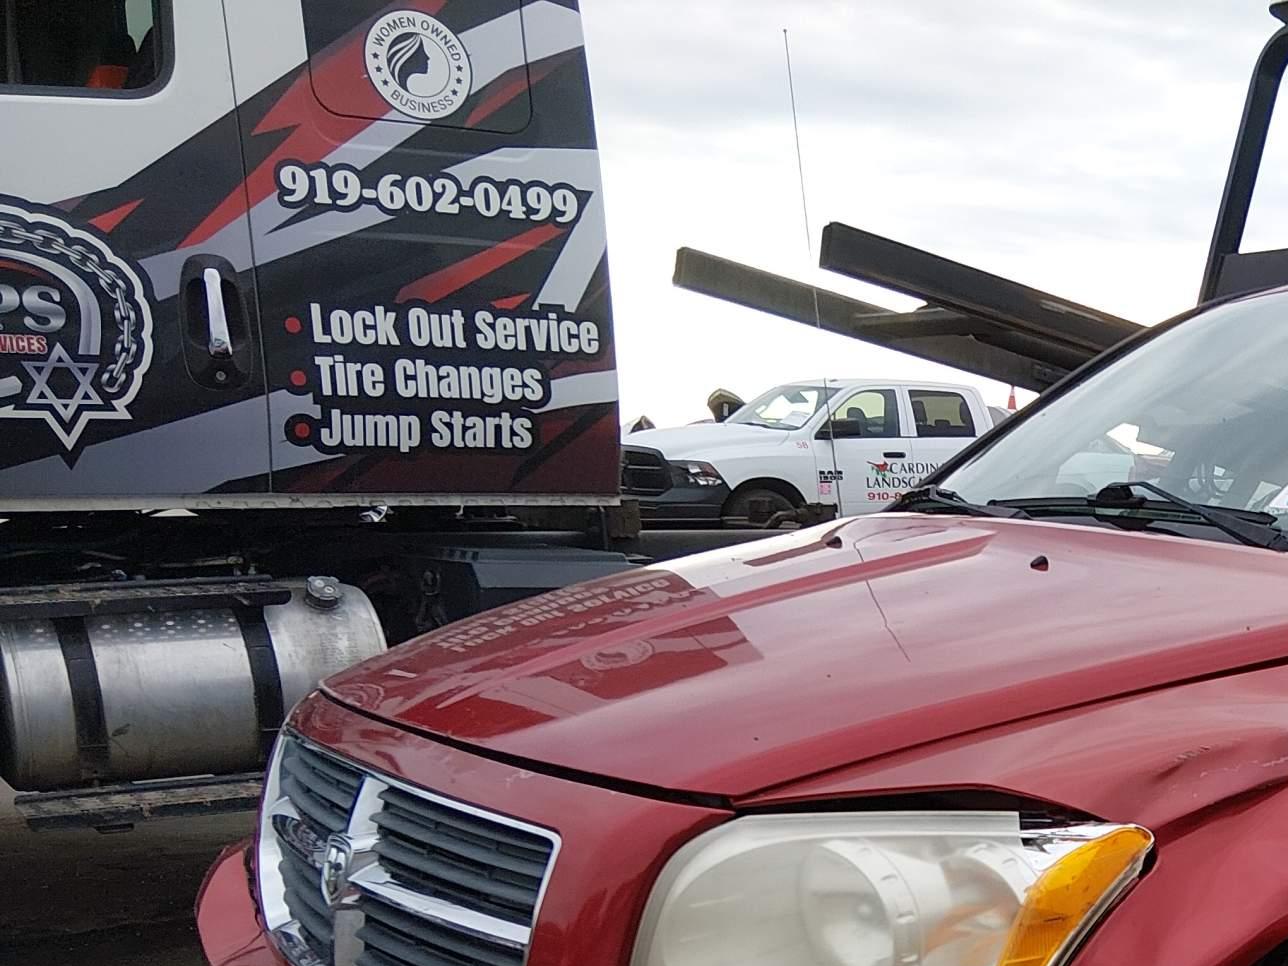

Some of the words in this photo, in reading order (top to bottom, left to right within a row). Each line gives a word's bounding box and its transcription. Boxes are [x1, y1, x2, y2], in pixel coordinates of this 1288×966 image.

[372, 16, 417, 48] WOMEN
[420, 20, 462, 62] OWNED
[390, 89, 454, 113] BUSINESS
[279, 165, 578, 223] 919-602-0499
[310, 303, 400, 346] Lock
[407, 307, 466, 348] Out
[475, 313, 599, 353] Service
[314, 355, 384, 397] Tire
[395, 359, 544, 403] Changes
[320, 409, 421, 452] Jump
[431, 410, 533, 449] Starts
